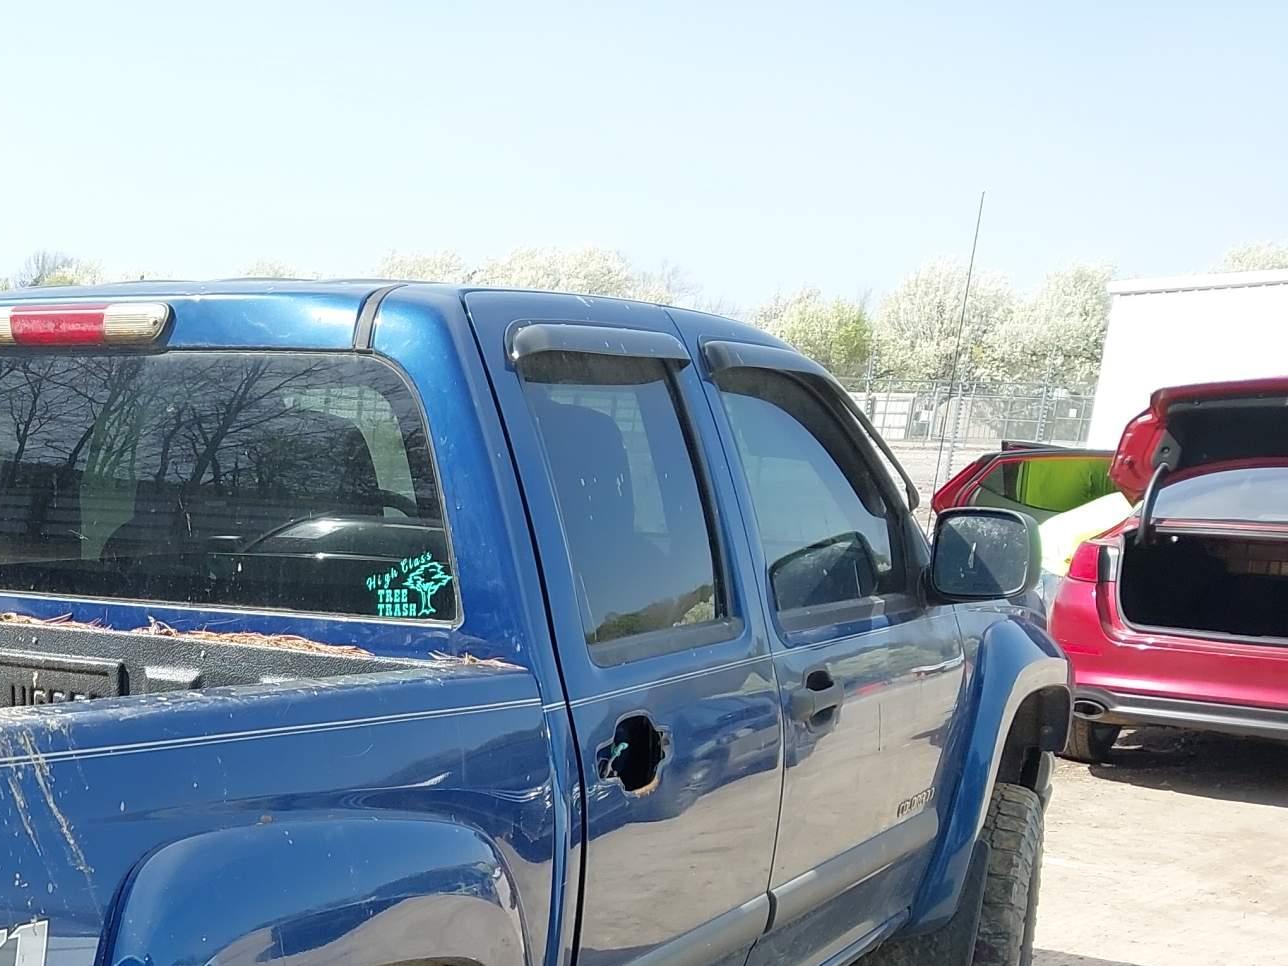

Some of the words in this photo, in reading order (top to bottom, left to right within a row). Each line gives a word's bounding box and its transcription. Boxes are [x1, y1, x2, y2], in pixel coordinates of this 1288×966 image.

[366, 567, 398, 591] High
[400, 551, 432, 574] Class
[377, 588, 409, 603] TREE
[377, 602, 417, 617] TRASH
